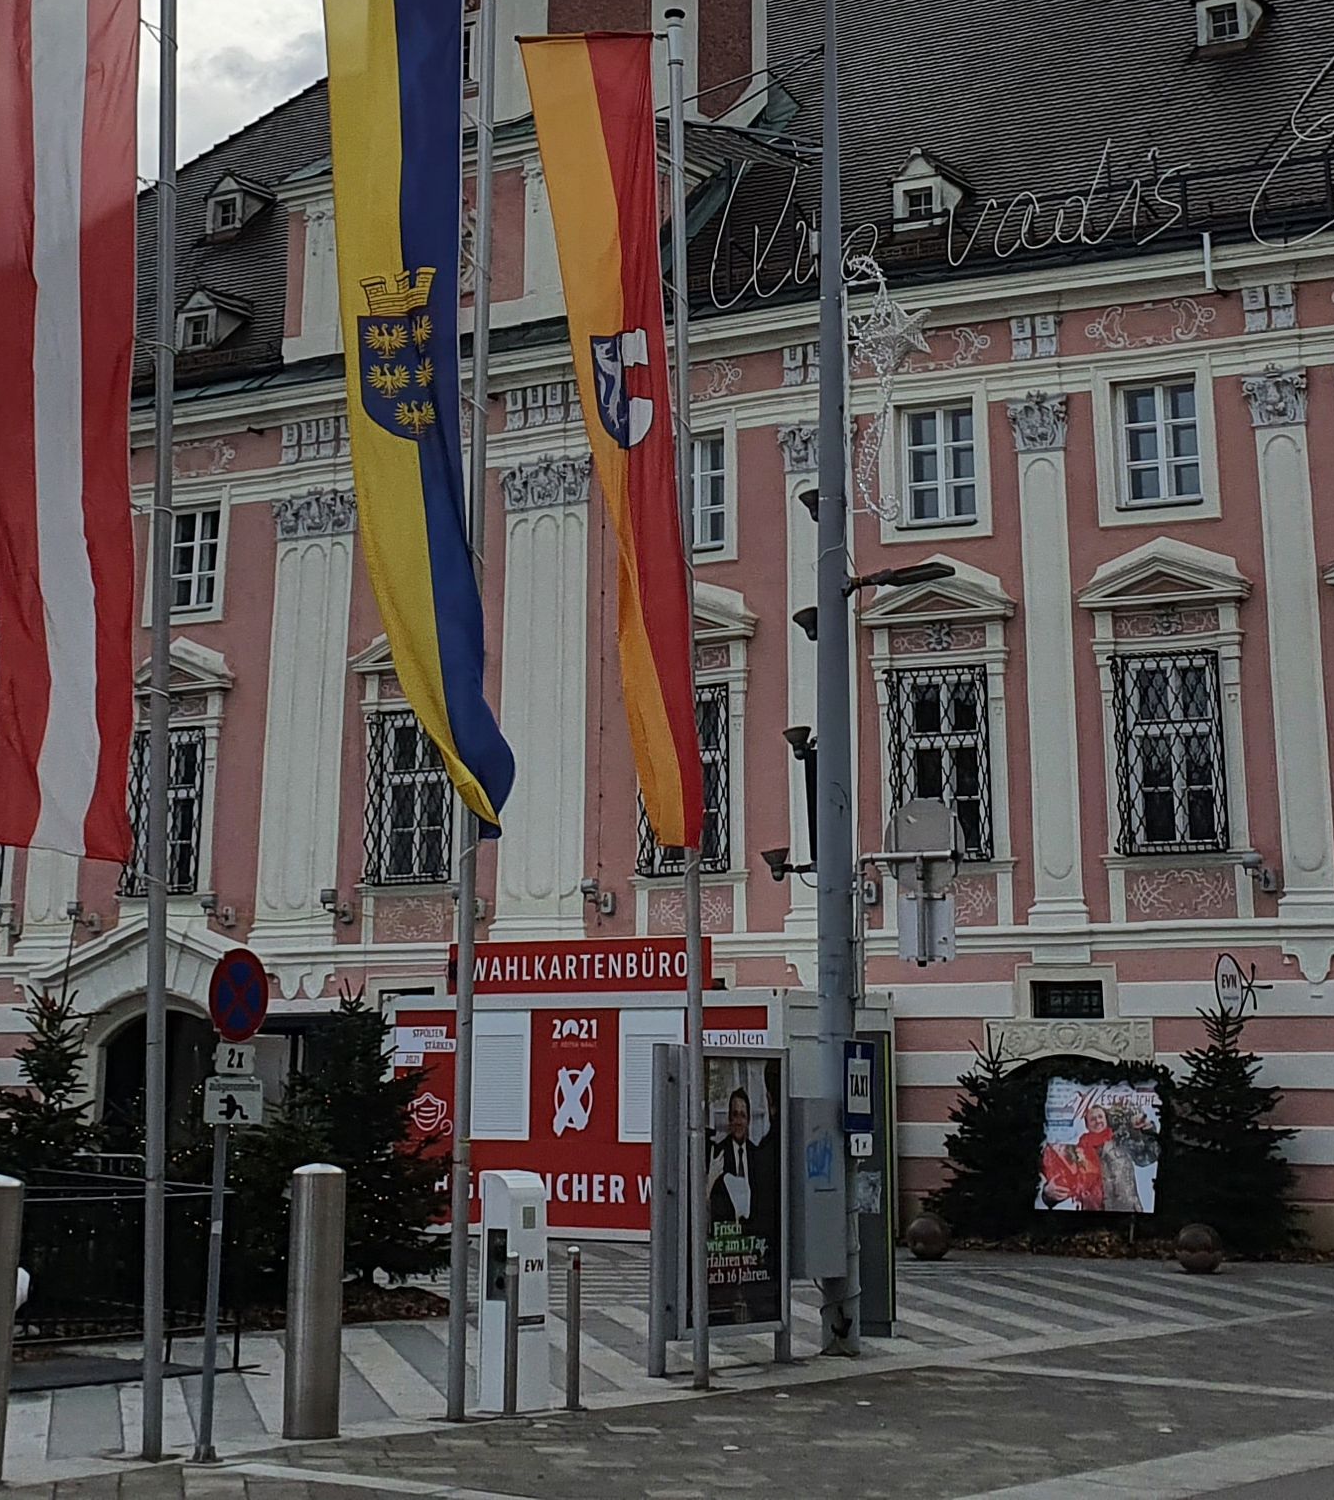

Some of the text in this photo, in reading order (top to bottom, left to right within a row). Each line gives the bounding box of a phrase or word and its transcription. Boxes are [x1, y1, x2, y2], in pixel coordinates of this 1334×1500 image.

[472, 946, 688, 982] WAHLKARTENBÜRO
[1221, 973, 1238, 989] EVN
[551, 1018, 598, 1040] 2021
[850, 1074, 869, 1097] TAXI
[545, 1172, 626, 1204] ICHER
[714, 1220, 743, 1237] Frisch
[725, 1240, 740, 1251] am
[524, 1258, 544, 1273] EVN
[707, 1252, 758, 1269] rfahren wie
[708, 1268, 725, 1285] ach
[738, 1267, 771, 1285] Jahren.
